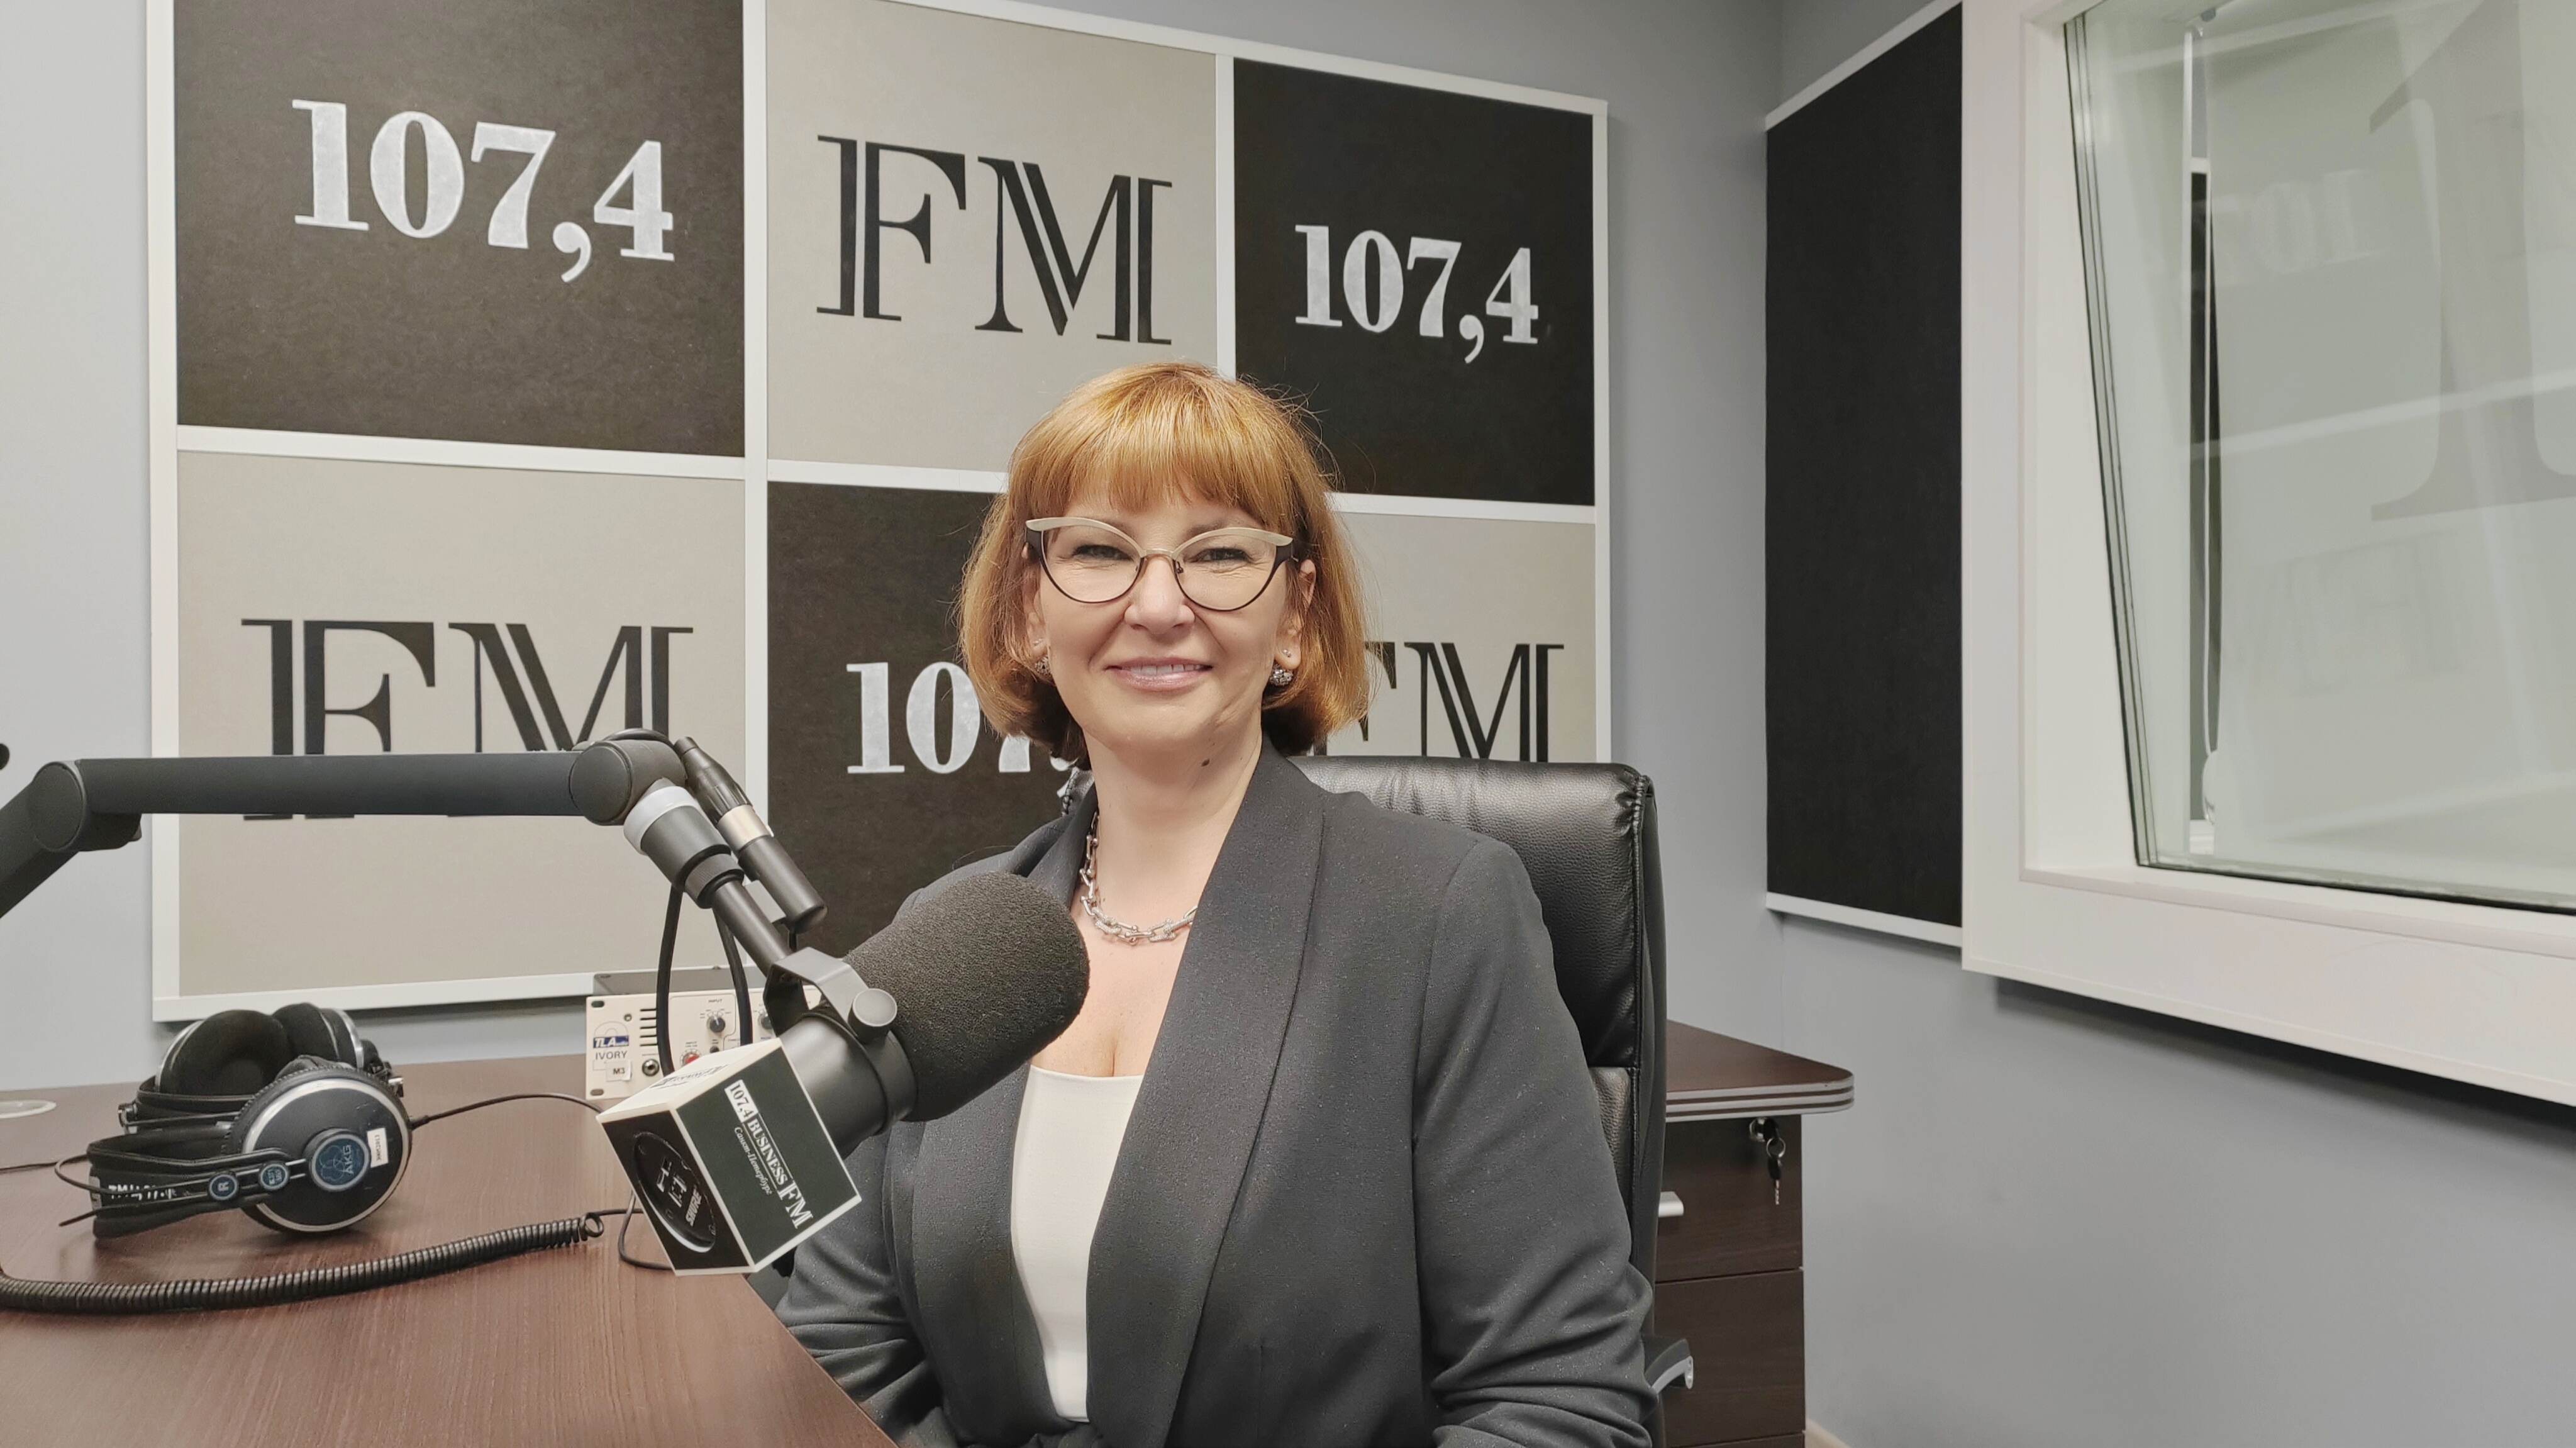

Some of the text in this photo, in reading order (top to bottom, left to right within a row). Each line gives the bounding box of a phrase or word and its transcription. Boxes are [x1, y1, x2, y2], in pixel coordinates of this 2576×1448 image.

[291, 99, 675, 282] 107,4
[816, 134, 1172, 345] FM
[1294, 223, 1540, 364] 107,4
[241, 618, 694, 820] FM
[595, 1050, 628, 1060] IVORY
[613, 1067, 626, 1075] M3
[218, 1181, 230, 1191] R
[340, 1144, 354, 1175] AKG
[730, 1082, 814, 1229] 107,4 BUSINESS FM
[685, 1184, 702, 1227] SHURE
